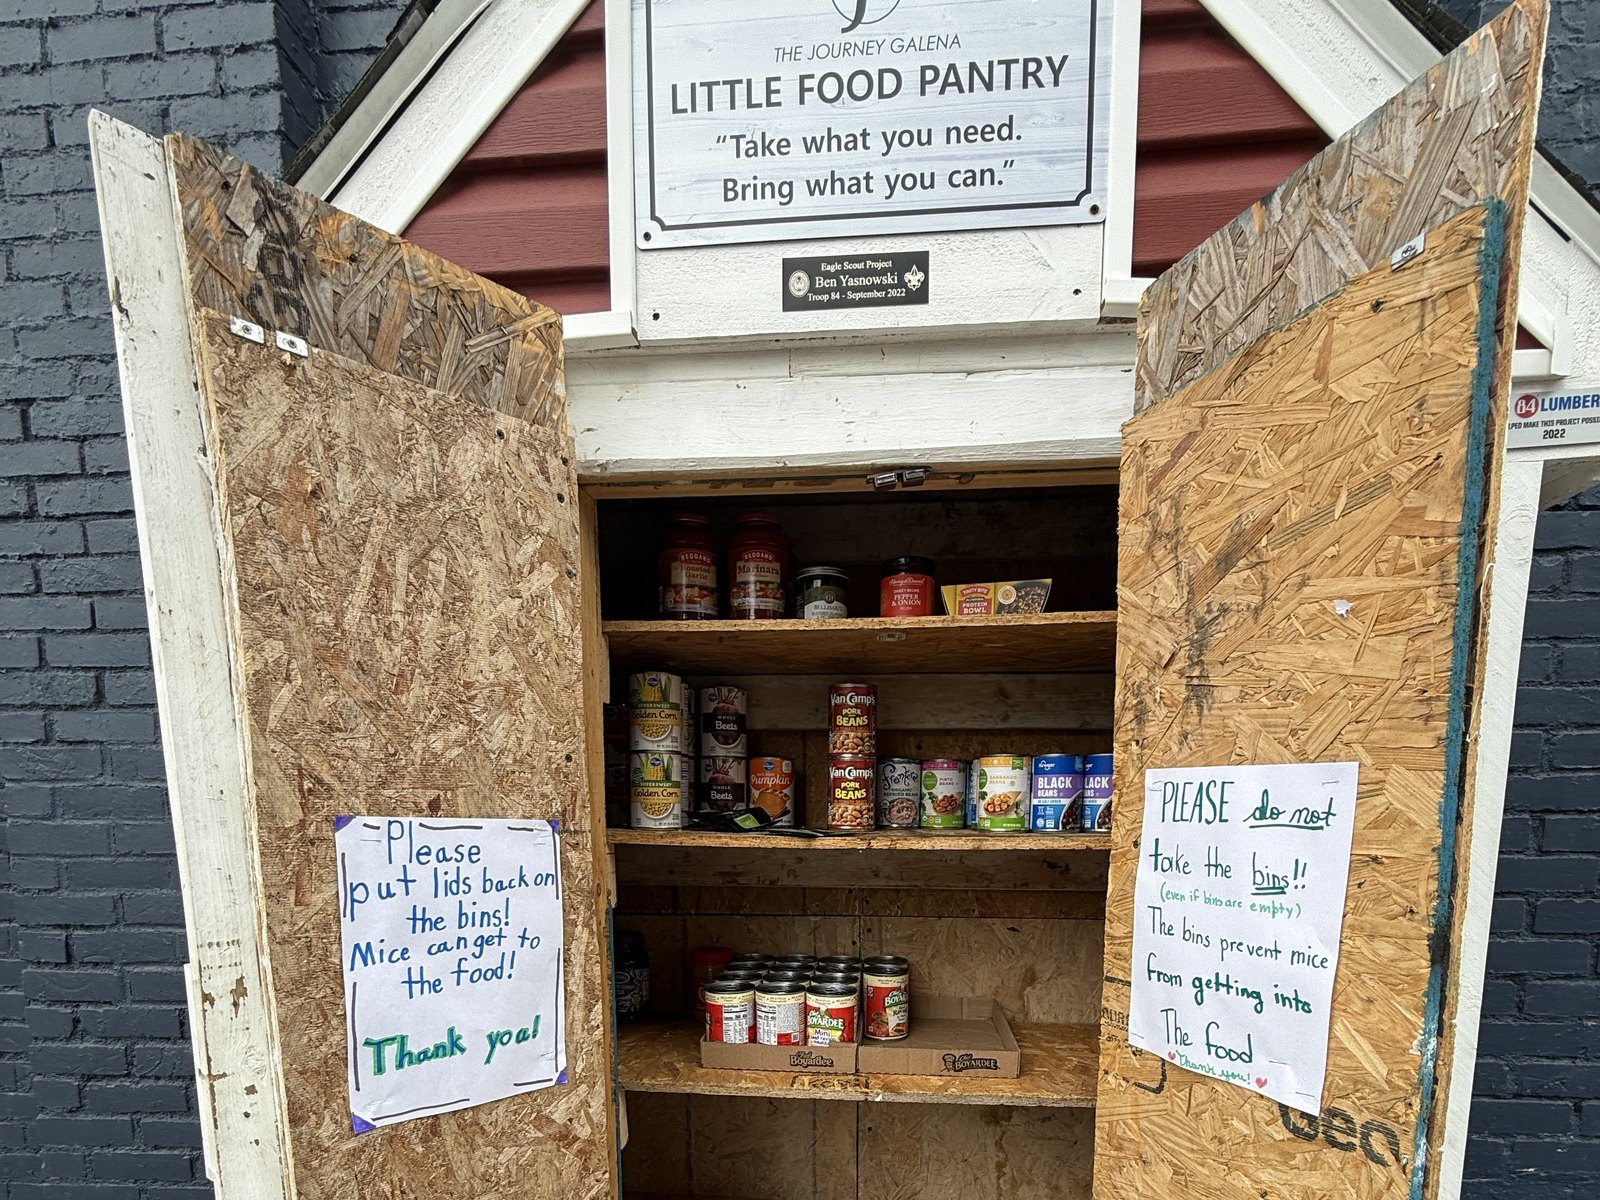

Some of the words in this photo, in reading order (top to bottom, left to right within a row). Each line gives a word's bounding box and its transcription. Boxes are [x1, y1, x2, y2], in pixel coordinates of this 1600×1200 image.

[774, 46, 803, 63] THE
[807, 39, 886, 60] JOURNEY
[890, 33, 961, 54] GALENA
[671, 76, 782, 115] LITTLE
[799, 67, 903, 105] FOOD
[919, 54, 1070, 97] PANTRY
[801, 128, 871, 154] what
[881, 126, 933, 157] you
[945, 115, 1023, 145] need.
[722, 176, 795, 206] Bring
[805, 171, 875, 198] what
[883, 170, 937, 200] you
[821, 262, 842, 273] Eagle
[843, 260, 865, 270] Scout
[866, 259, 893, 271] Project
[815, 276, 837, 288] Ben
[839, 272, 898, 287] Yasnowski
[807, 292, 829, 302] Troop
[831, 291, 840, 300] 84
[847, 290, 886, 301] September
[887, 288, 906, 298] 2022
[1516, 398, 1537, 414] 84
[1540, 393, 1600, 412] LUMBER
[1508, 422, 1522, 430] LPED
[1523, 421, 1540, 429] MAKE
[1556, 418, 1581, 426] PROJECT
[1542, 428, 1566, 440] 2022
[737, 563, 780, 576] Marinara
[894, 593, 919, 601] PEPPER
[631, 709, 658, 720] Golden
[659, 709, 678, 720] Corn
[842, 707, 862, 716] PORK
[715, 721, 738, 731] Beets
[836, 715, 868, 726] BEANS
[751, 774, 790, 788] Pumpkin
[840, 781, 860, 789] PORK
[1037, 776, 1072, 789] BLACK
[1084, 776, 1109, 789] LACK
[633, 788, 659, 798] Golden
[661, 788, 679, 798] Corn
[710, 790, 733, 800] Beets
[835, 788, 867, 800] BEANS
[1037, 789, 1058, 797] BEANS
[1160, 780, 1234, 825] PLEASE
[1243, 789, 1286, 823] do
[1289, 797, 1337, 828] not
[387, 820, 482, 865] Please
[1148, 838, 1192, 877] take
[1204, 845, 1232, 880] the
[1252, 852, 1307, 890] bins!!
[349, 864, 416, 922] put
[433, 866, 472, 899] lids
[482, 865, 527, 894] back
[534, 871, 555, 888] on
[1159, 881, 1187, 902] (even
[1189, 888, 1201, 904] if
[1224, 897, 1243, 909] are
[1249, 899, 1302, 919] empty)
[406, 904, 447, 934] the
[457, 897, 510, 931] bins!
[1147, 905, 1175, 937] The
[1182, 917, 1211, 949] bins
[1220, 935, 1282, 963] prevent
[1290, 945, 1329, 970] mice
[349, 939, 410, 971] Mice
[427, 935, 469, 957] can
[472, 927, 507, 959] get
[517, 927, 541, 950] to
[400, 966, 444, 999] the
[450, 951, 516, 987] food!
[1191, 972, 1265, 1014] getting
[1273, 983, 1313, 1015] into
[814, 1028, 831, 1037] Mini
[1160, 1007, 1193, 1048] The
[1205, 1021, 1253, 1064] food
[362, 1026, 467, 1076] Thank
[796, 1050, 812, 1060] Chef
[789, 1054, 834, 1068] Boyardee
[955, 1058, 998, 1070] BOYARDEE
[1175, 1049, 1218, 1077] Thank
[1219, 1065, 1251, 1085] you!
